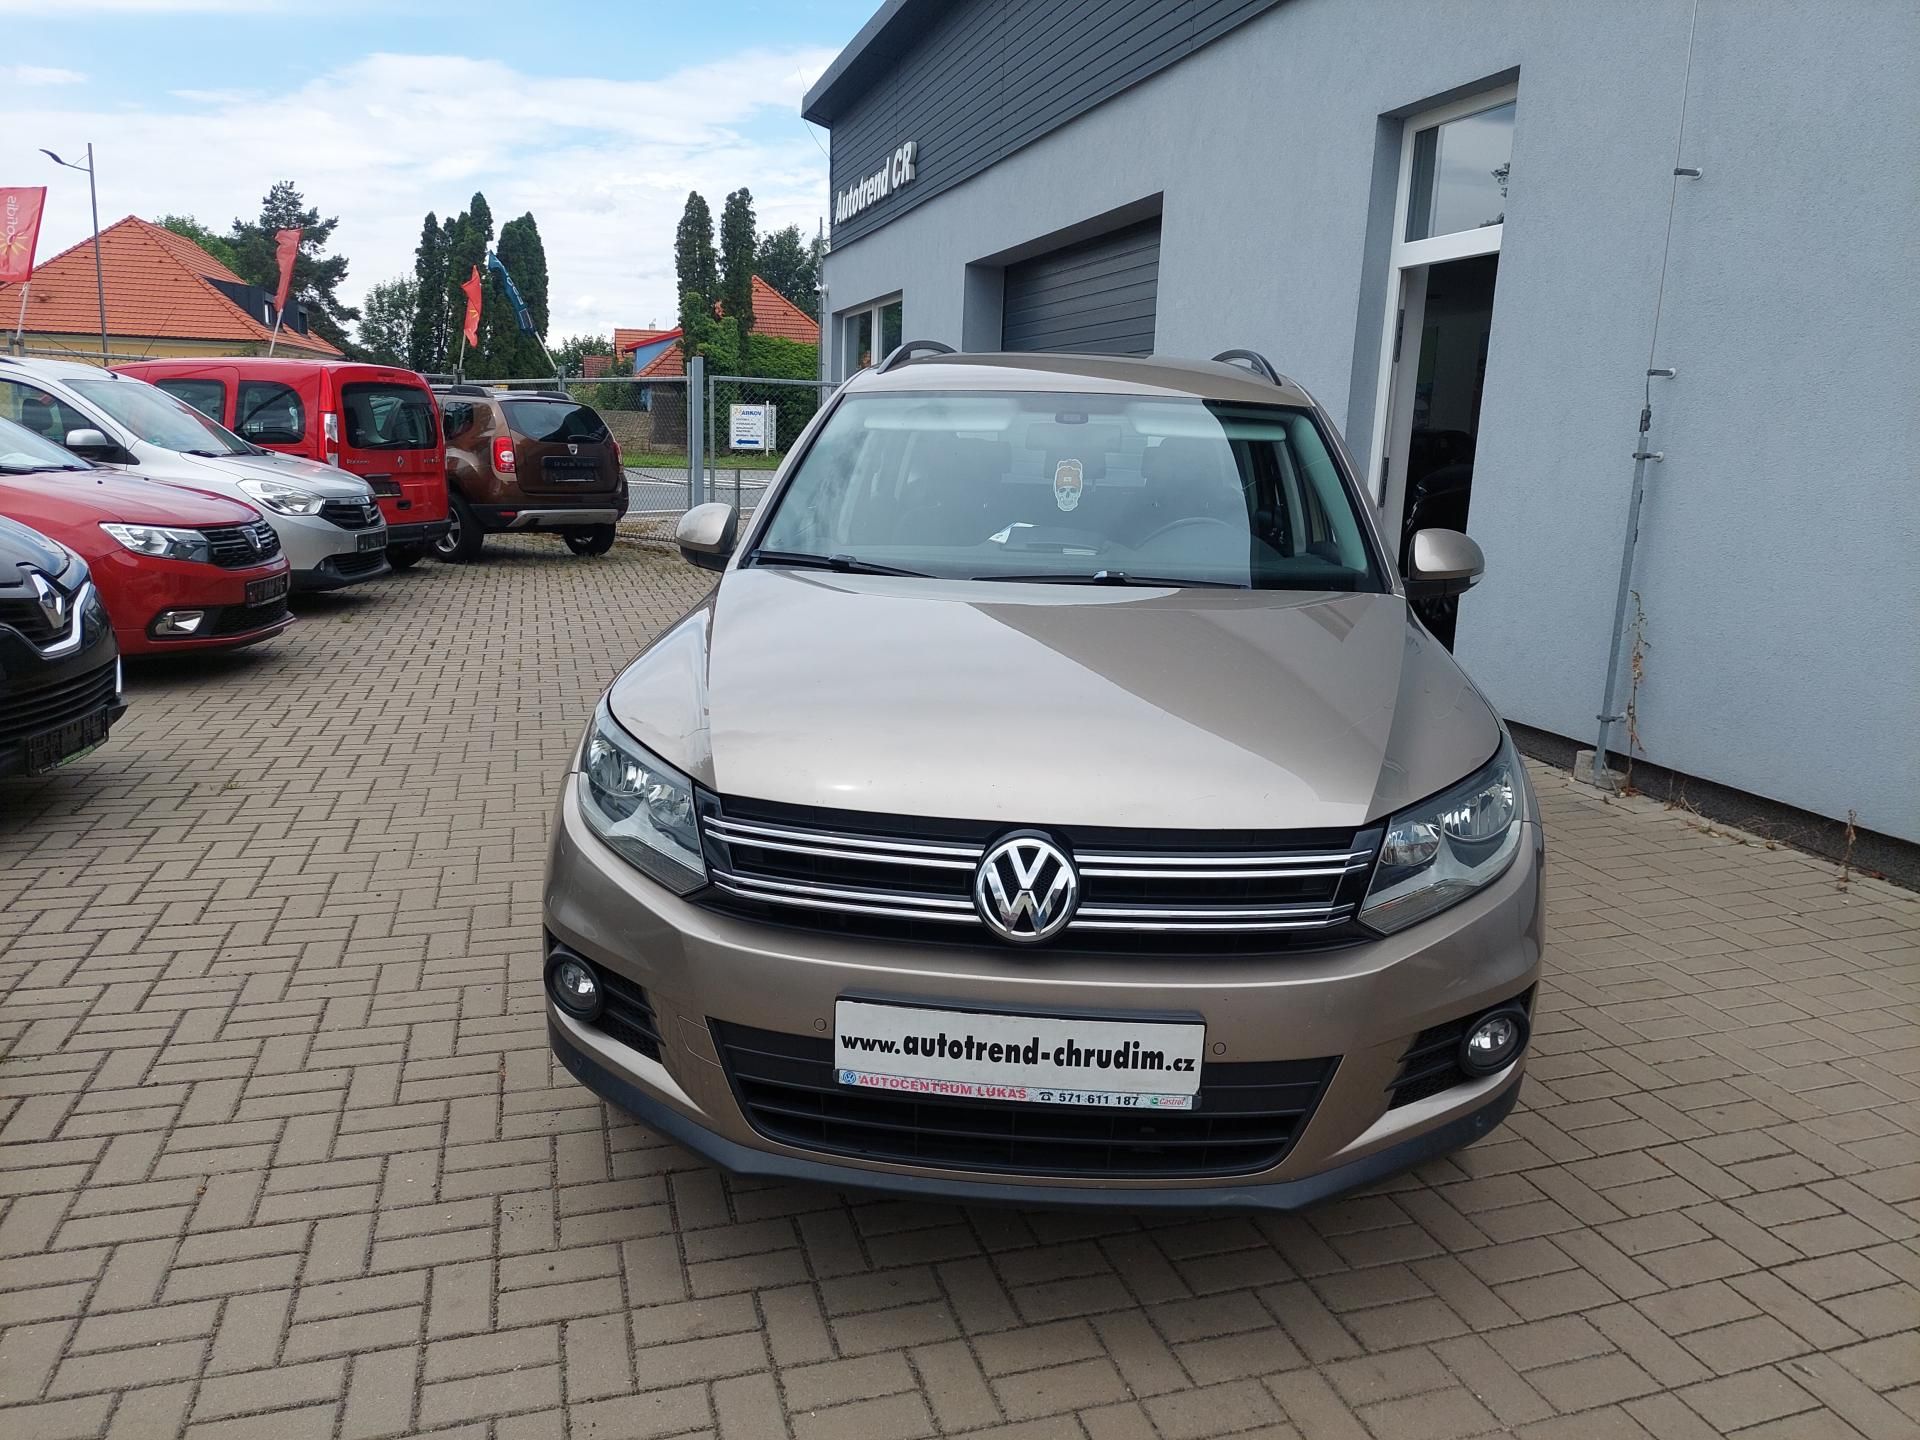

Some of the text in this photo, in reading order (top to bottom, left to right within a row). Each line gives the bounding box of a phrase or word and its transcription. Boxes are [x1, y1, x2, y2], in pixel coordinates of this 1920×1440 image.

[834, 141, 915, 225] Autotrend CR
[840, 1033, 1195, 1072] www.autotrend-chrudim.cz
[859, 1074, 972, 1095] AUTOCENTRUM
[1058, 1093, 1081, 1103] 571
[1086, 1094, 1109, 1105] 611
[1115, 1095, 1139, 1106] 187
